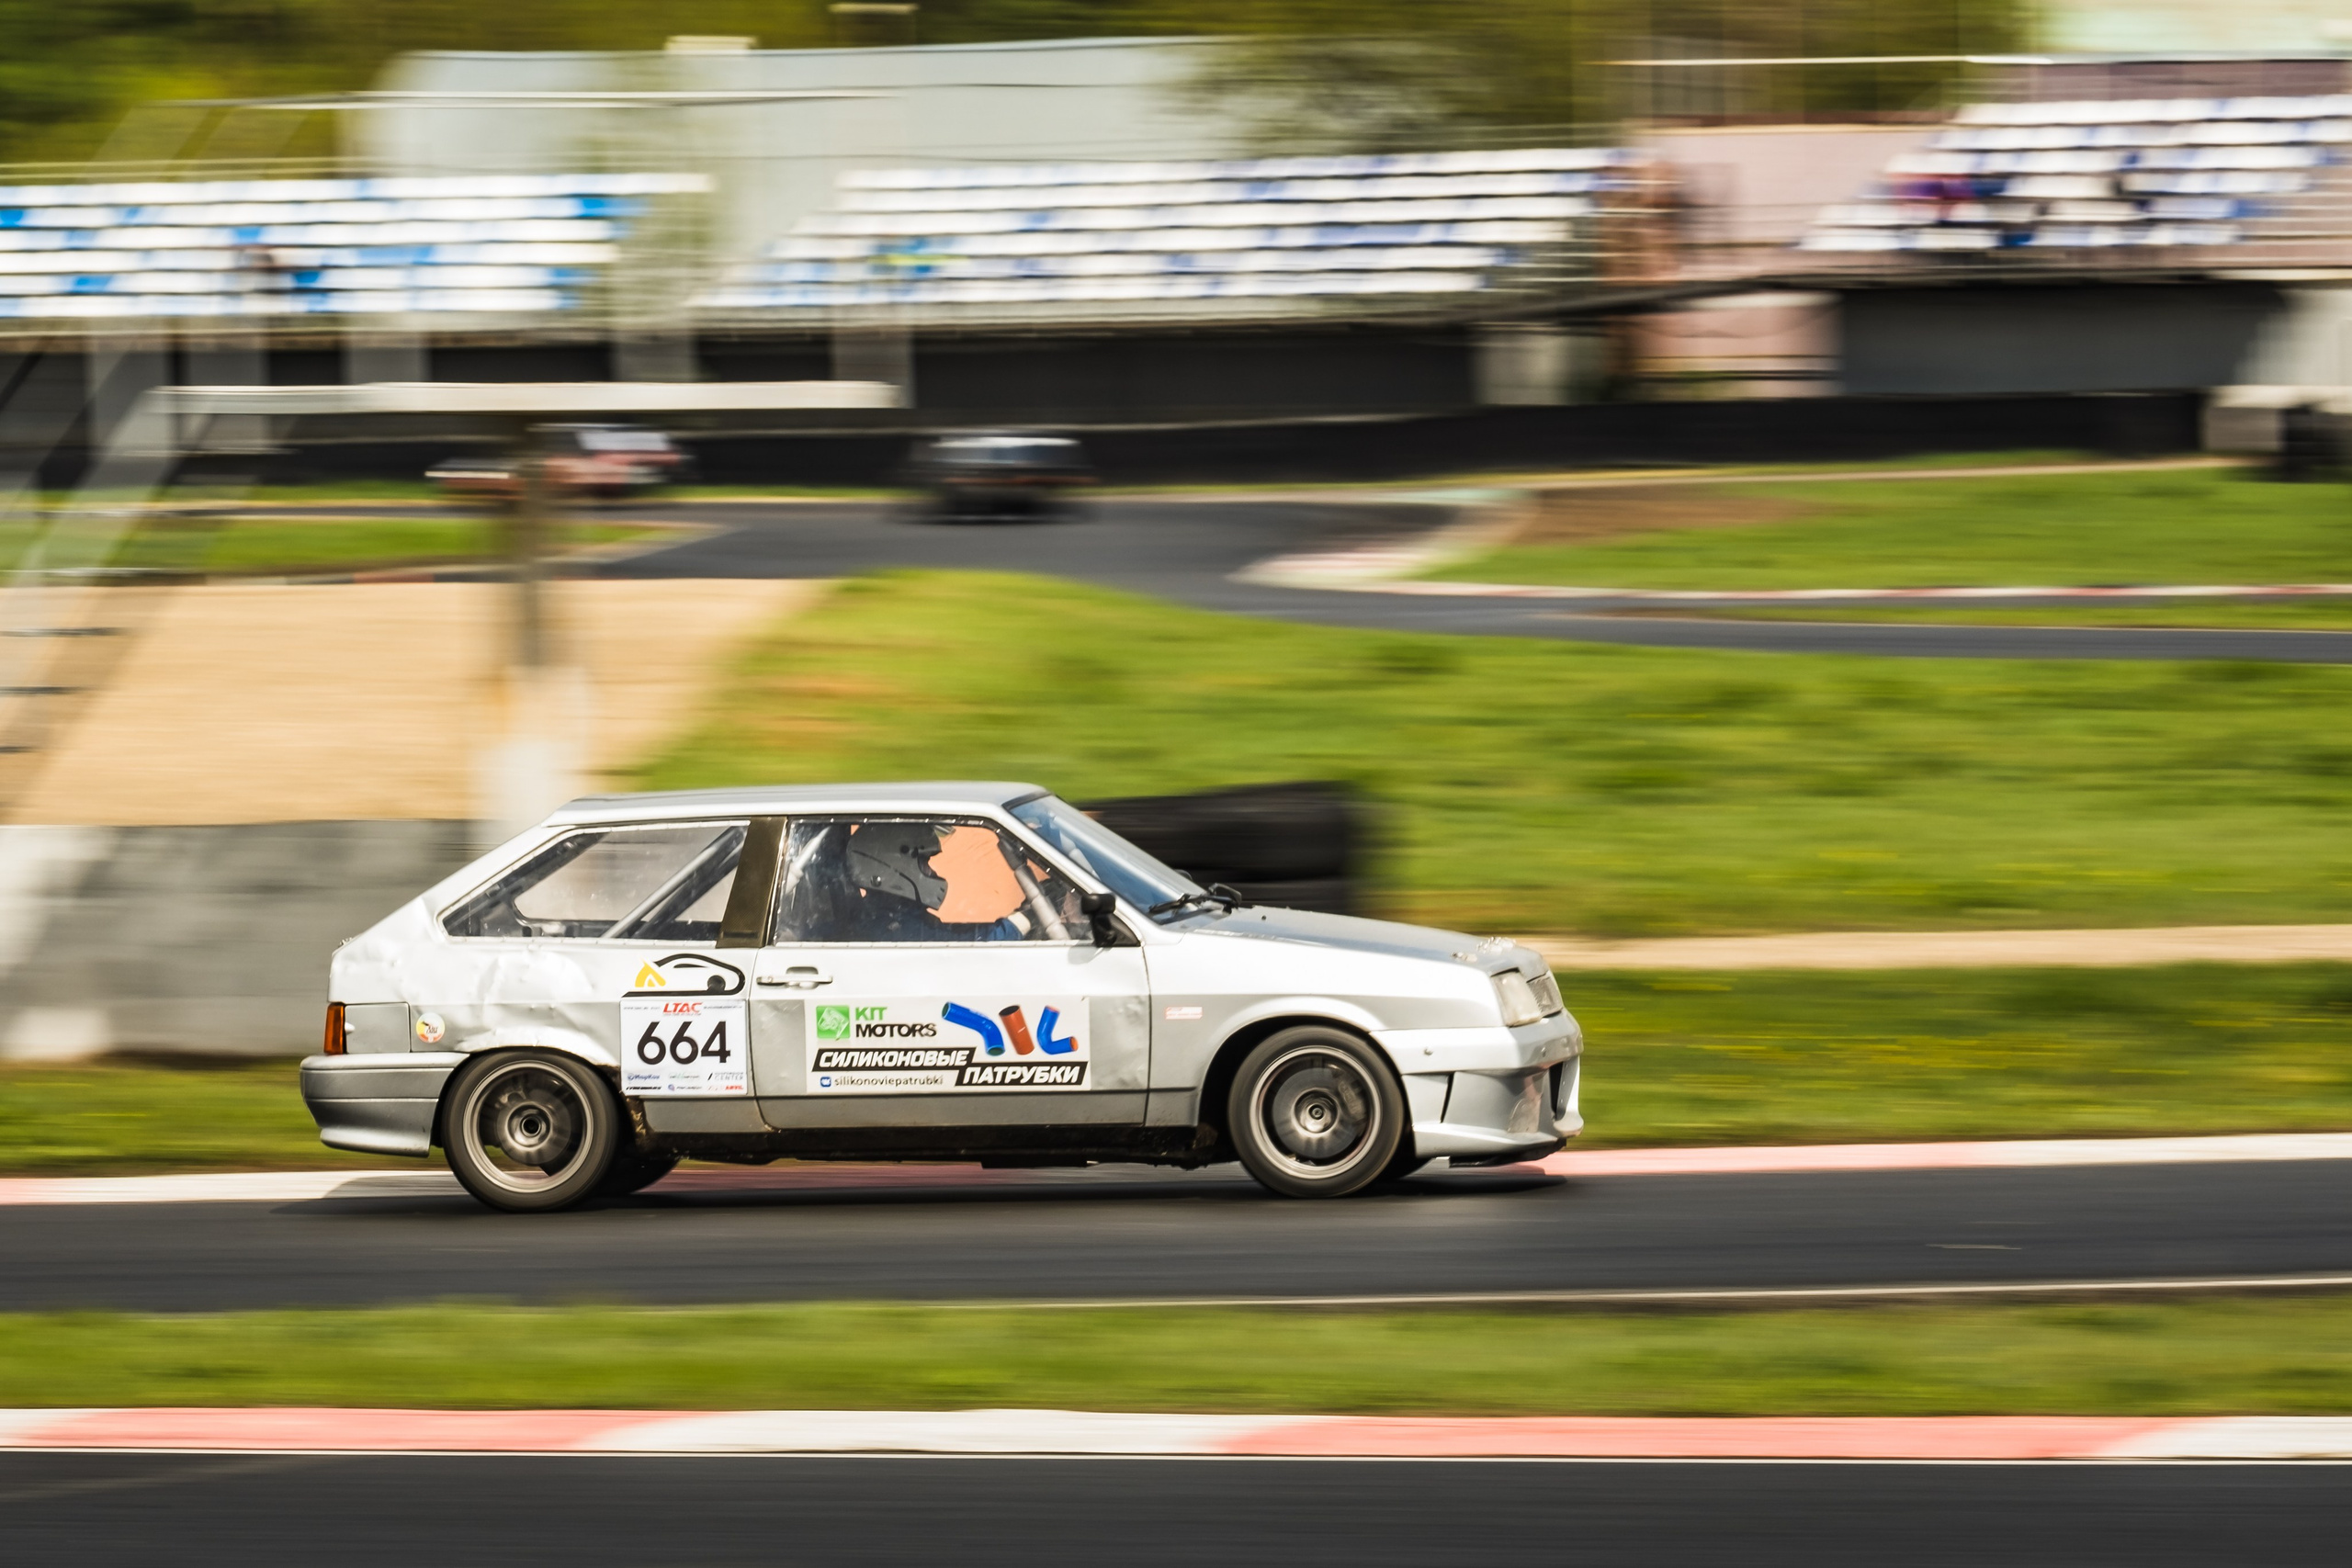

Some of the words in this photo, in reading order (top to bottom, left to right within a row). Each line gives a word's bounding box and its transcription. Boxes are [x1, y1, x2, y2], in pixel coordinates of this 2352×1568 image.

[662, 1001, 704, 1013] LTAC
[855, 1007, 888, 1021] KIT
[855, 1023, 937, 1038] MOTORS
[637, 1021, 731, 1066] 664
[819, 1050, 970, 1068] СИЛИКОНОВЫЕ
[834, 1076, 944, 1088] silikonoviepatrubki
[963, 1066, 1081, 1085] ПАТРУБКИ
